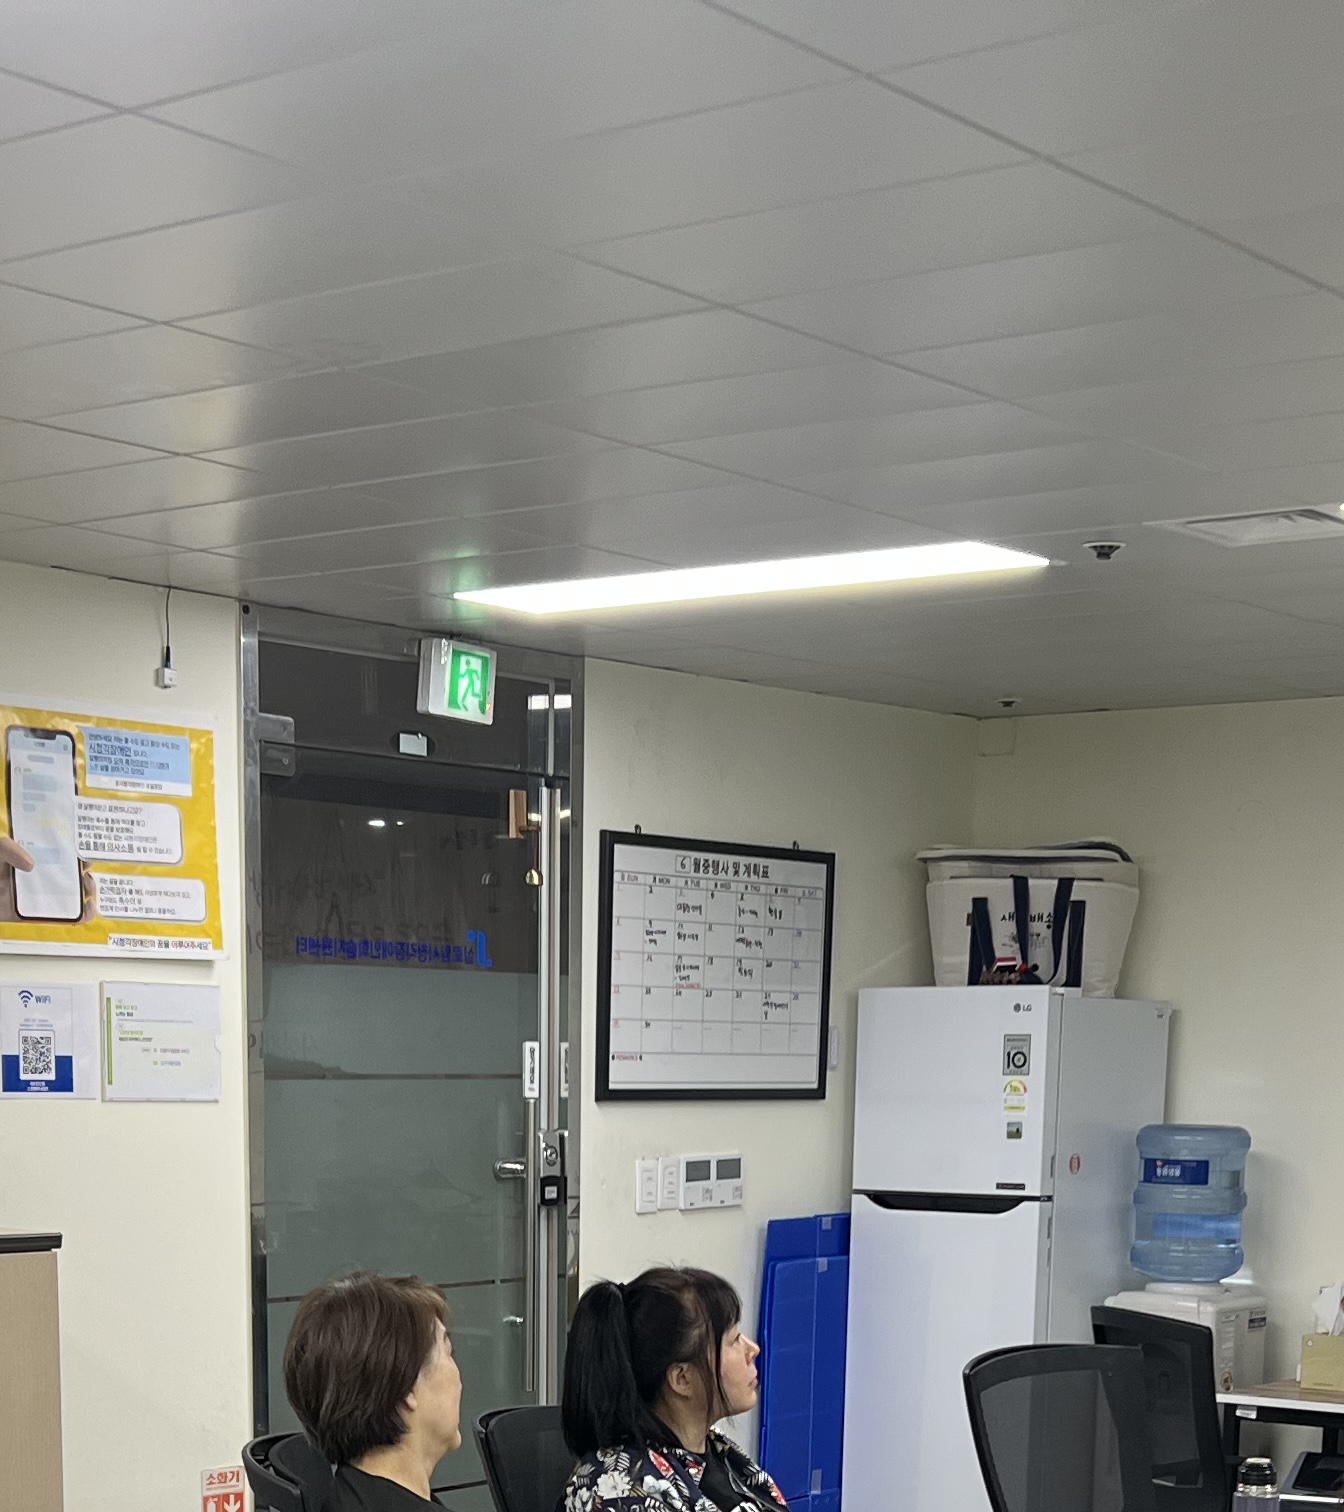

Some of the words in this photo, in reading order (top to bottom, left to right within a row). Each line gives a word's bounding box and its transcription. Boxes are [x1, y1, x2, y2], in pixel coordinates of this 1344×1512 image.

[89, 742, 132, 757] 시청각장애인
[680, 857, 687, 869] 6
[692, 856, 730, 876] 월중행사
[732, 862, 741, 877] 및
[742, 864, 770, 880] 계획표
[1022, 1004, 1032, 1012] LG
[205, 1469, 241, 1486] 소화기
